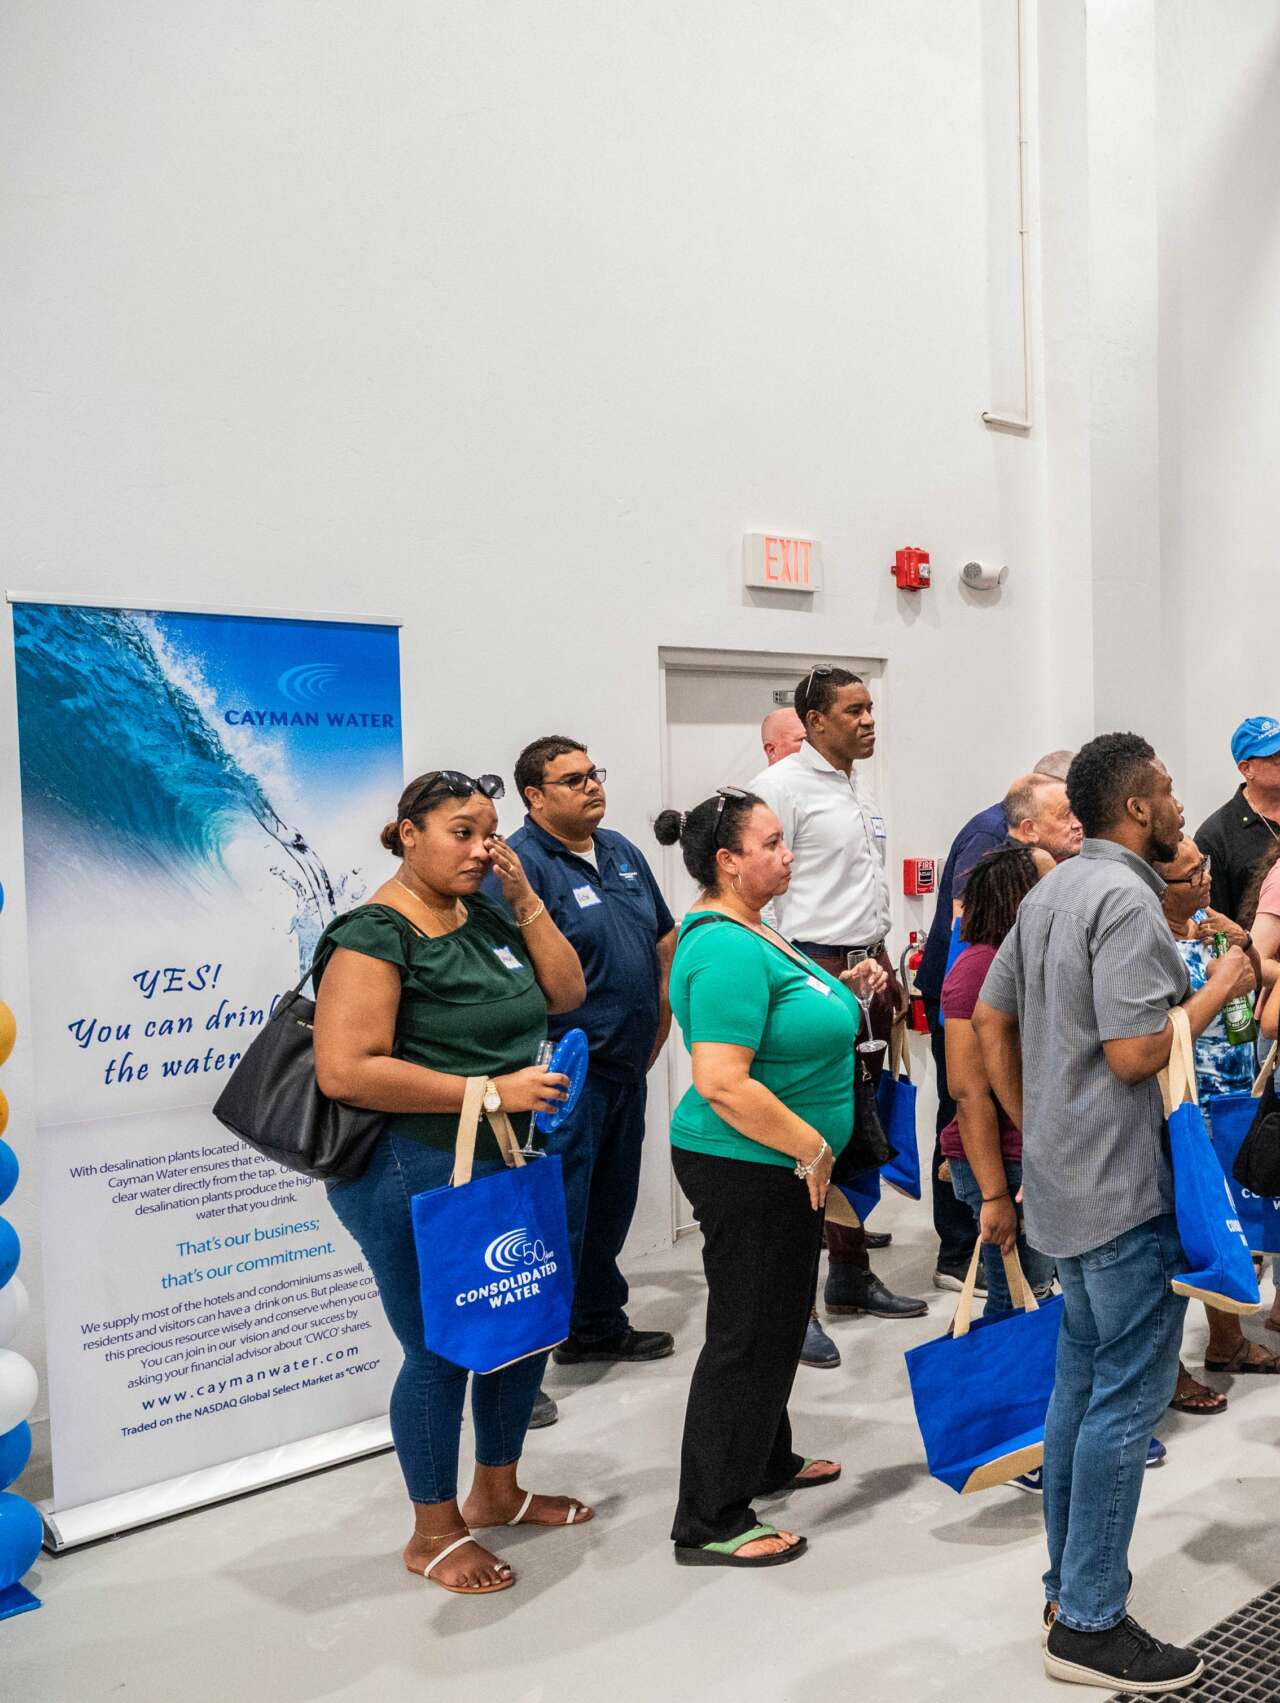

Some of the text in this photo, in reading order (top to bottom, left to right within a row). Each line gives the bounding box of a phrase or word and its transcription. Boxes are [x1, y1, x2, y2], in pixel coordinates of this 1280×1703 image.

[764, 537, 812, 585] EXIT
[225, 710, 394, 729] CAYMAN WATER
[133, 963, 222, 999] YES!
[68, 1018, 132, 1049] You
[144, 1016, 193, 1038] can
[104, 1048, 241, 1085] the water
[70, 1165, 98, 1178] With
[99, 1155, 166, 1174] desalination
[168, 1149, 200, 1165] plants
[201, 1141, 240, 1157] located
[108, 1173, 155, 1189] Cayman
[156, 1167, 188, 1181] Water
[189, 1161, 230, 1175] ensures
[231, 1156, 252, 1167] that
[112, 1191, 137, 1204] clear
[140, 1187, 171, 1199] water
[172, 1178, 211, 1194] directly
[212, 1173, 238, 1187] from
[239, 1170, 257, 1181] the
[258, 1168, 277, 1179] tap.
[135, 1197, 200, 1216] desalination
[201, 1191, 233, 1206] plants
[234, 1183, 278, 1200] produce
[278, 1179, 295, 1189] the
[196, 1193, 297, 1221] water that you drink.
[176, 1219, 320, 1257] That's our business;
[523, 1239, 546, 1265] 50
[161, 1241, 336, 1289] that's our commitment.
[80, 1322, 101, 1335] We
[102, 1313, 140, 1331] supply
[141, 1308, 170, 1321] most
[171, 1302, 183, 1315] of
[183, 1300, 202, 1312] the
[203, 1291, 235, 1307] hotels
[236, 1286, 257, 1300] and
[258, 1271, 332, 1295] condominiums
[332, 1269, 344, 1278] as
[455, 1261, 557, 1307] CONSOLIDATED
[489, 1282, 541, 1309] WATER
[83, 1332, 134, 1351] residents
[135, 1324, 157, 1339] and
[158, 1318, 196, 1333] visitors
[196, 1313, 216, 1324] can
[217, 1307, 243, 1319] have
[244, 1305, 251, 1313] a
[254, 1297, 280, 1311] drink
[281, 1295, 295, 1305] on
[296, 1291, 310, 1301] us.
[311, 1286, 328, 1298] But
[329, 1280, 359, 1296] please
[105, 1348, 125, 1362] this
[127, 1338, 173, 1359] precious
[175, 1327, 220, 1345] resource
[221, 1318, 253, 1334] wisely
[254, 1313, 274, 1327] and
[275, 1304, 319, 1321] conserve
[320, 1297, 347, 1310] when
[348, 1292, 366, 1306] you
[127, 1371, 163, 1389] asking
[164, 1365, 190, 1382] your
[190, 1352, 234, 1373] financial
[235, 1346, 273, 1362] advisor
[274, 1337, 302, 1352] about
[341, 1320, 373, 1335] shares.
[140, 1308, 359, 1369] You can join in our vision and our success by
[120, 1419, 157, 1437] Traded
[159, 1417, 174, 1427] on
[175, 1411, 192, 1423] the
[194, 1398, 238, 1417] NASDAQ
[239, 1389, 271, 1405] Global
[272, 1382, 300, 1396] Select
[302, 1373, 334, 1389] Market
[335, 1371, 345, 1379] as
